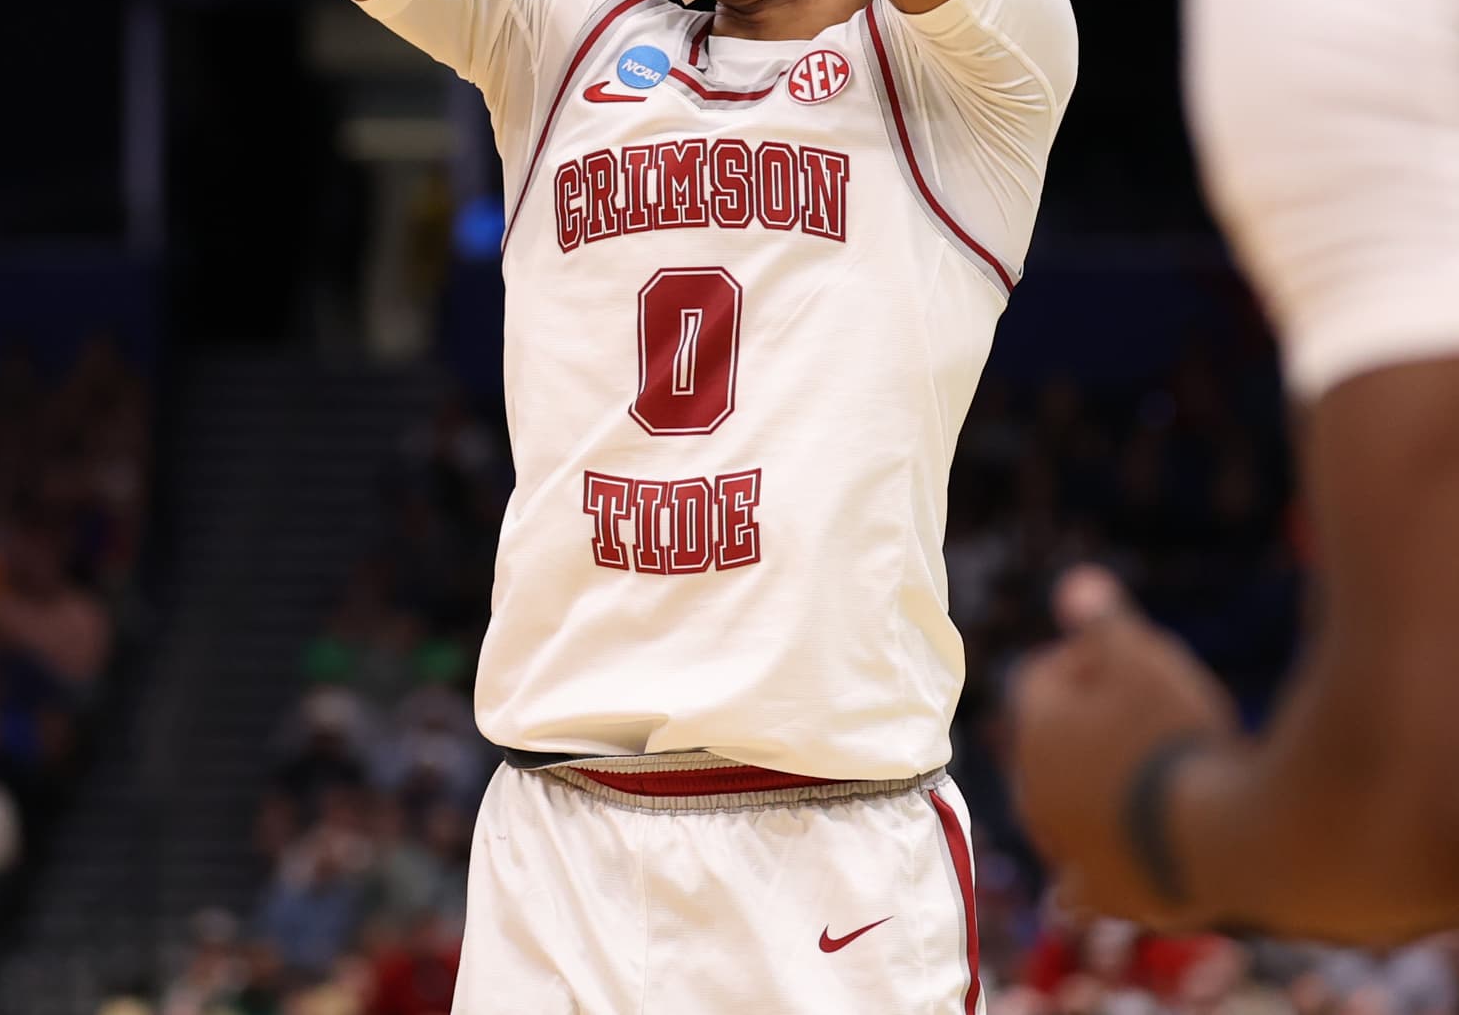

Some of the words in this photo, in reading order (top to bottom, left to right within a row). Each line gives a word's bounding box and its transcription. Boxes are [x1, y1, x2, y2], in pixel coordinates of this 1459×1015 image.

[621, 58, 662, 84] NCAA
[791, 51, 846, 101] SEC
[554, 138, 850, 254] CRIMSON
[628, 266, 743, 437] 0
[583, 468, 762, 575] TIDE
